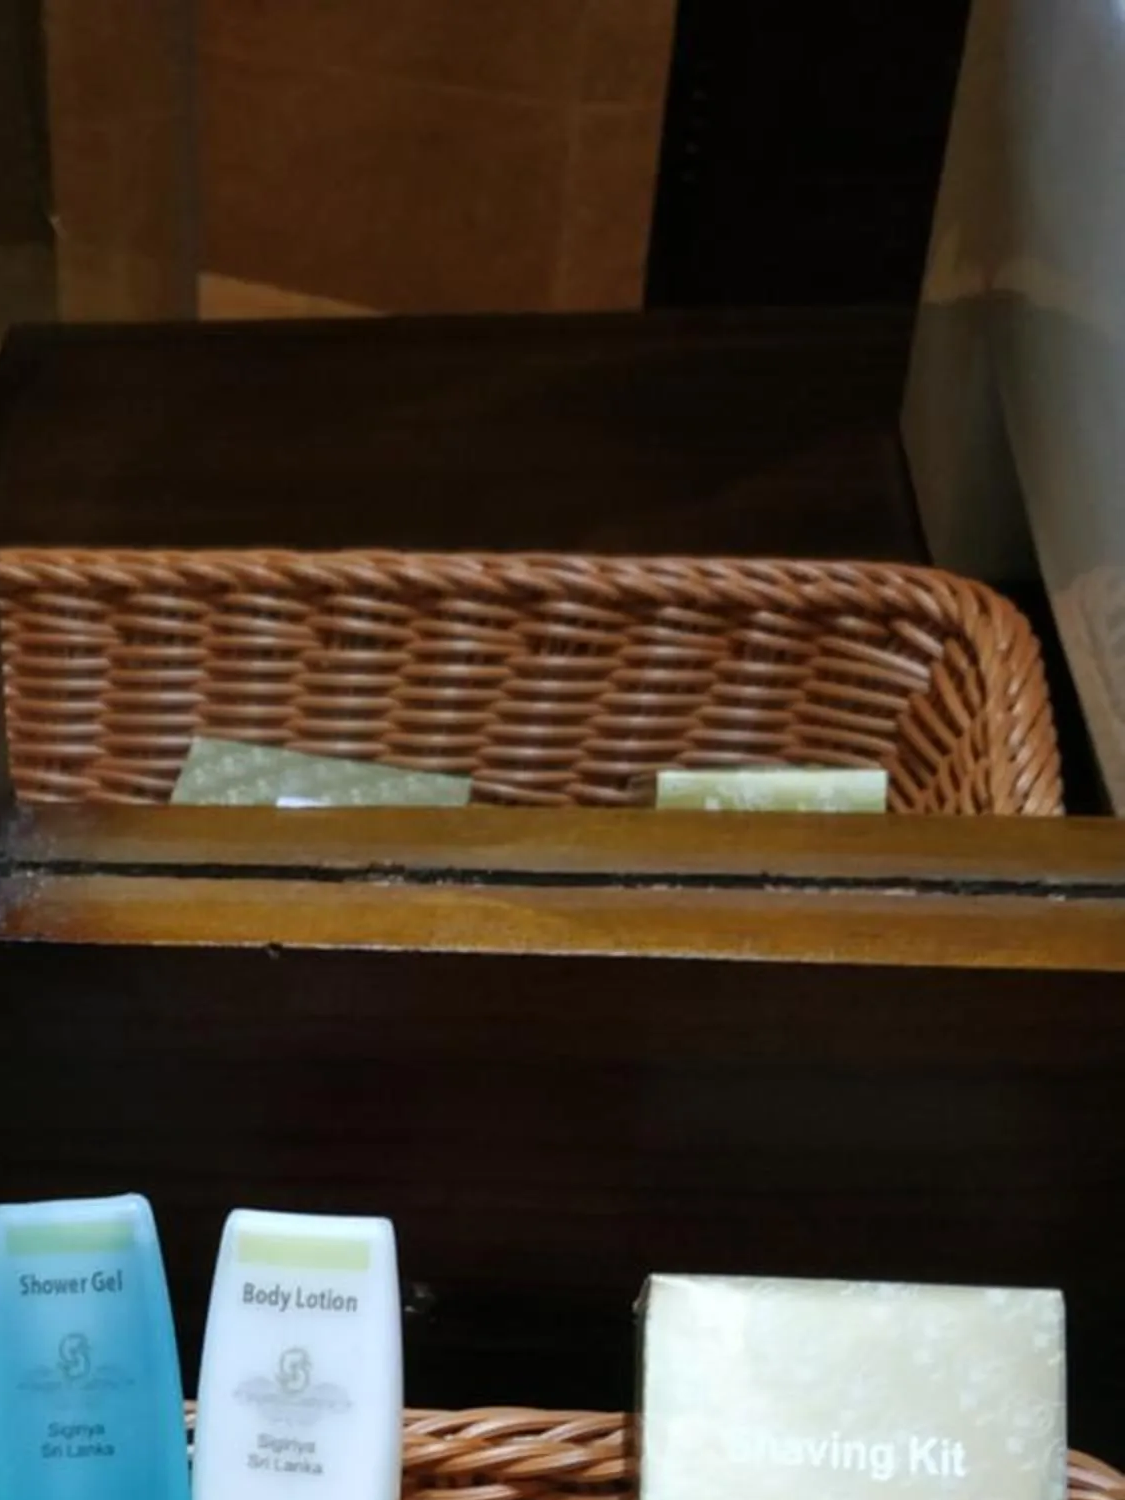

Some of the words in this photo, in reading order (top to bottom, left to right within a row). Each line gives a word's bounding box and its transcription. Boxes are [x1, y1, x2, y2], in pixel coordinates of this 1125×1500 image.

[19, 1274, 87, 1296] Shower
[91, 1269, 123, 1293] Gel
[242, 1282, 292, 1312] Body
[295, 1287, 359, 1312] Lotion
[908, 1435, 967, 1477] Kit
